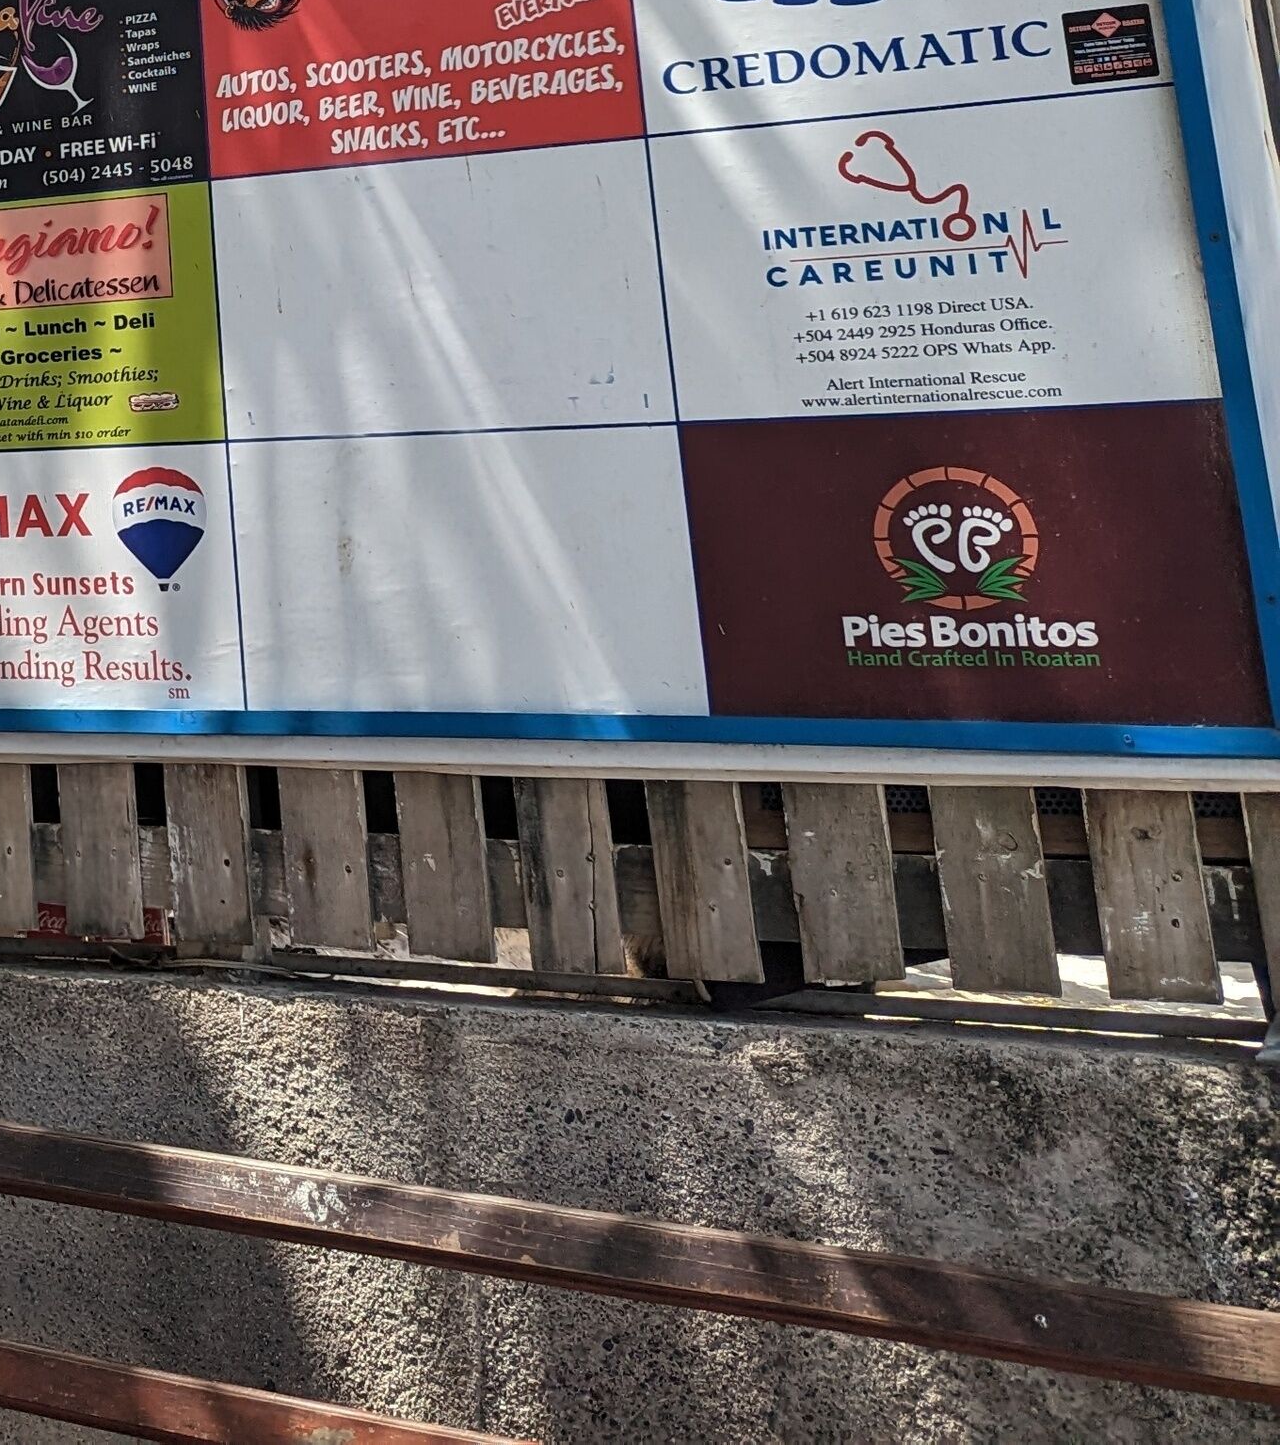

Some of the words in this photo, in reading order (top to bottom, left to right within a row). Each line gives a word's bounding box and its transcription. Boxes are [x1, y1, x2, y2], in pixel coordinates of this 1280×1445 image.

[127, 50, 191, 66] Sandwiches
[216, 66, 297, 100] AUTOS,
[305, 50, 432, 89] SCOOTERS,
[439, 26, 626, 73] MOTORCYCLES,
[662, 20, 1052, 95] CREDOMATIC
[128, 66, 177, 80] Cocktails
[222, 101, 310, 133] LIQUOR,
[319, 93, 385, 122] BEER,
[392, 82, 462, 113] WINE,
[470, 63, 624, 106] BEVERAGES,
[12, 118, 53, 133] WINE
[61, 114, 93, 129] BAR
[330, 119, 429, 155] SNACKS,
[437, 116, 506, 145] ETC...
[0, 146, 37, 166] DAY
[59, 139, 106, 160] FREE
[13, 272, 160, 307] Delicatessen
[24, 317, 88, 337] Lunch
[113, 312, 156, 331] Deli
[920, 317, 997, 338] Honduras
[999, 315, 1053, 333] Office.
[0, 346, 103, 366] Groceries
[922, 342, 958, 358] OPS
[962, 340, 1013, 357] Whats
[1017, 338, 1056, 355] App.
[826, 377, 865, 392] Alert
[869, 371, 966, 389] International
[969, 369, 1027, 385] Rescue
[801, 384, 1063, 409] www.alertinternationalrescue.com
[32, 571, 135, 596] Sunsets
[56, 604, 159, 645] Agents
[842, 615, 927, 649] Pies
[932, 615, 1099, 649] Bonitos
[83, 650, 193, 682] Results.
[847, 650, 903, 668] Hand
[907, 650, 990, 668] Crafted
[994, 650, 1016, 668] In
[1021, 650, 1101, 668] Roatan
